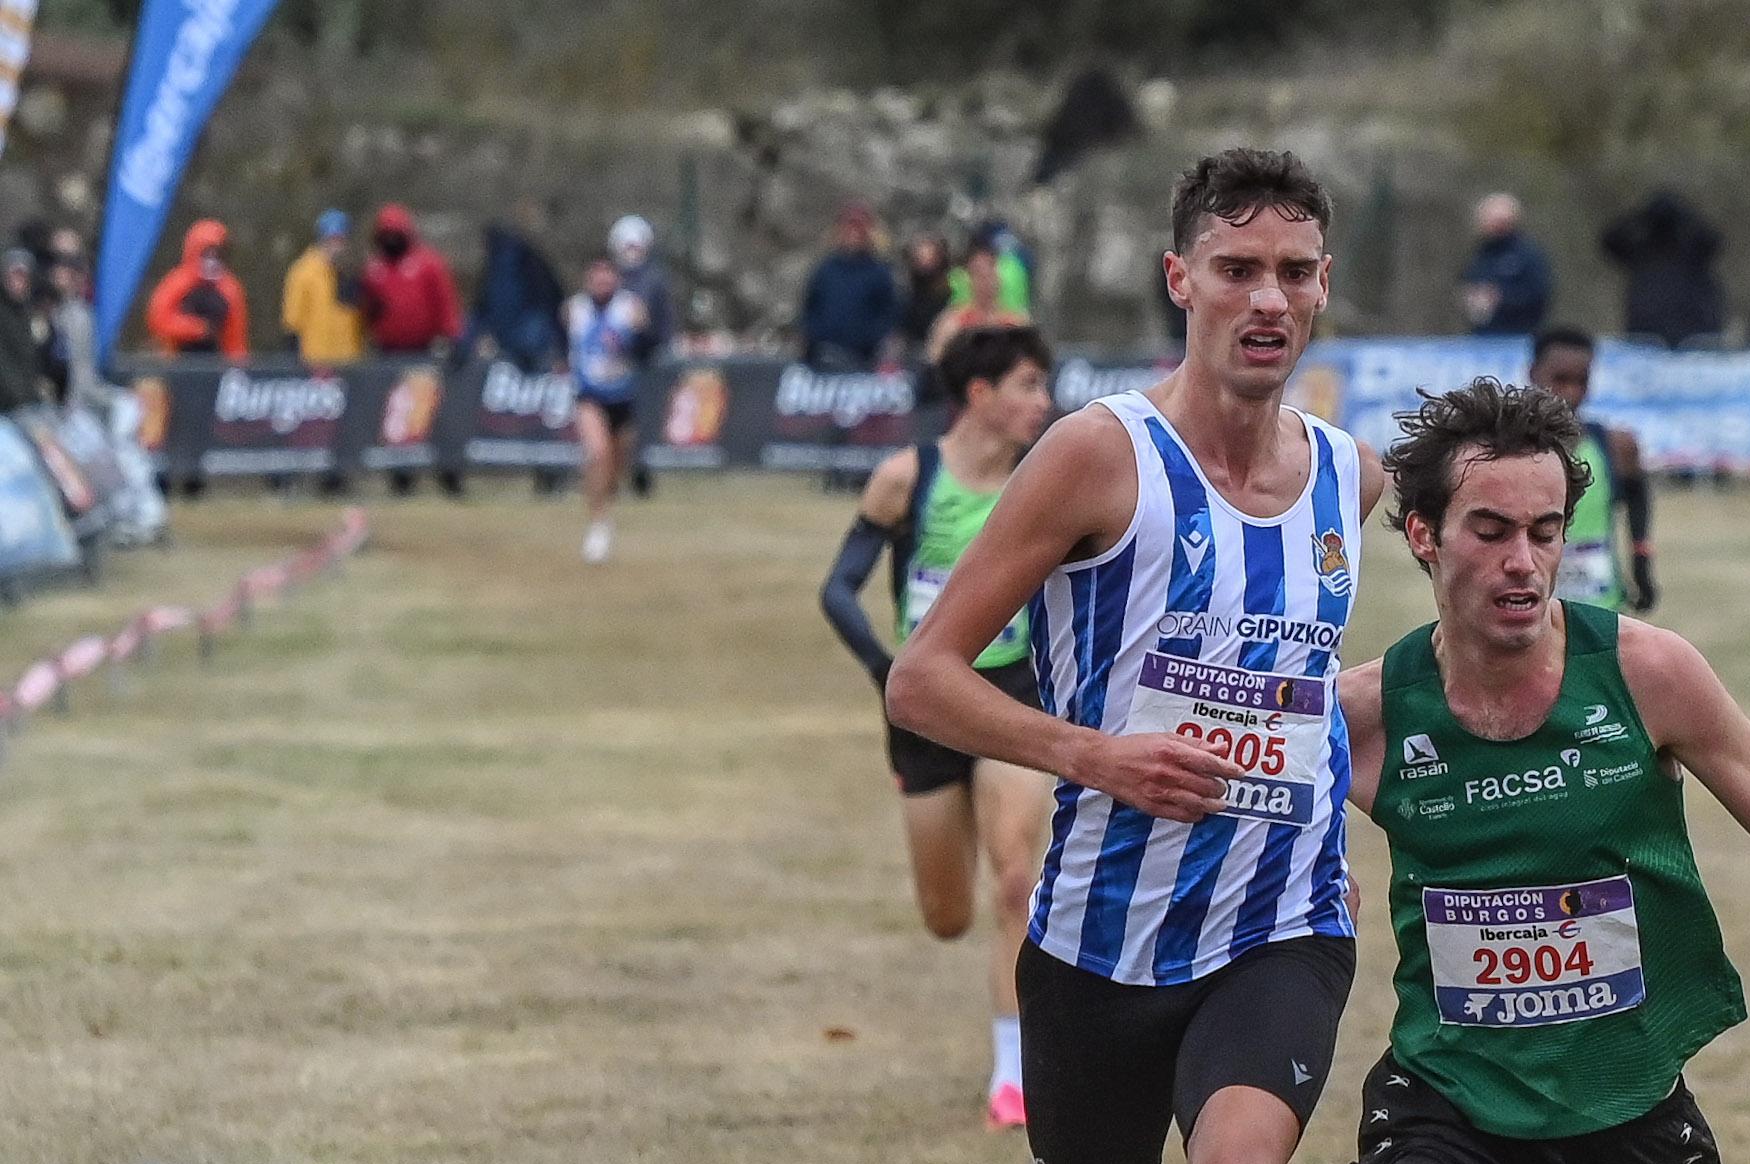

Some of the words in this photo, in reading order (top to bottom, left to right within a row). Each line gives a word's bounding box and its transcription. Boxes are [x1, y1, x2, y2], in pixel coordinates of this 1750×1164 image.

[1157, 614, 1232, 639] ORAIN
[1165, 661, 1266, 691] DIPUTACIÓN
[1162, 677, 1263, 706] BURGOS
[1193, 702, 1257, 727] Ibercaja
[1465, 765, 1567, 804] Facsa
[1444, 890, 1544, 908] DIPUTACIÓN
[1445, 908, 1546, 922] BURGOS
[1480, 925, 1548, 942] Ibercaja
[1472, 941, 1594, 985] 2904
